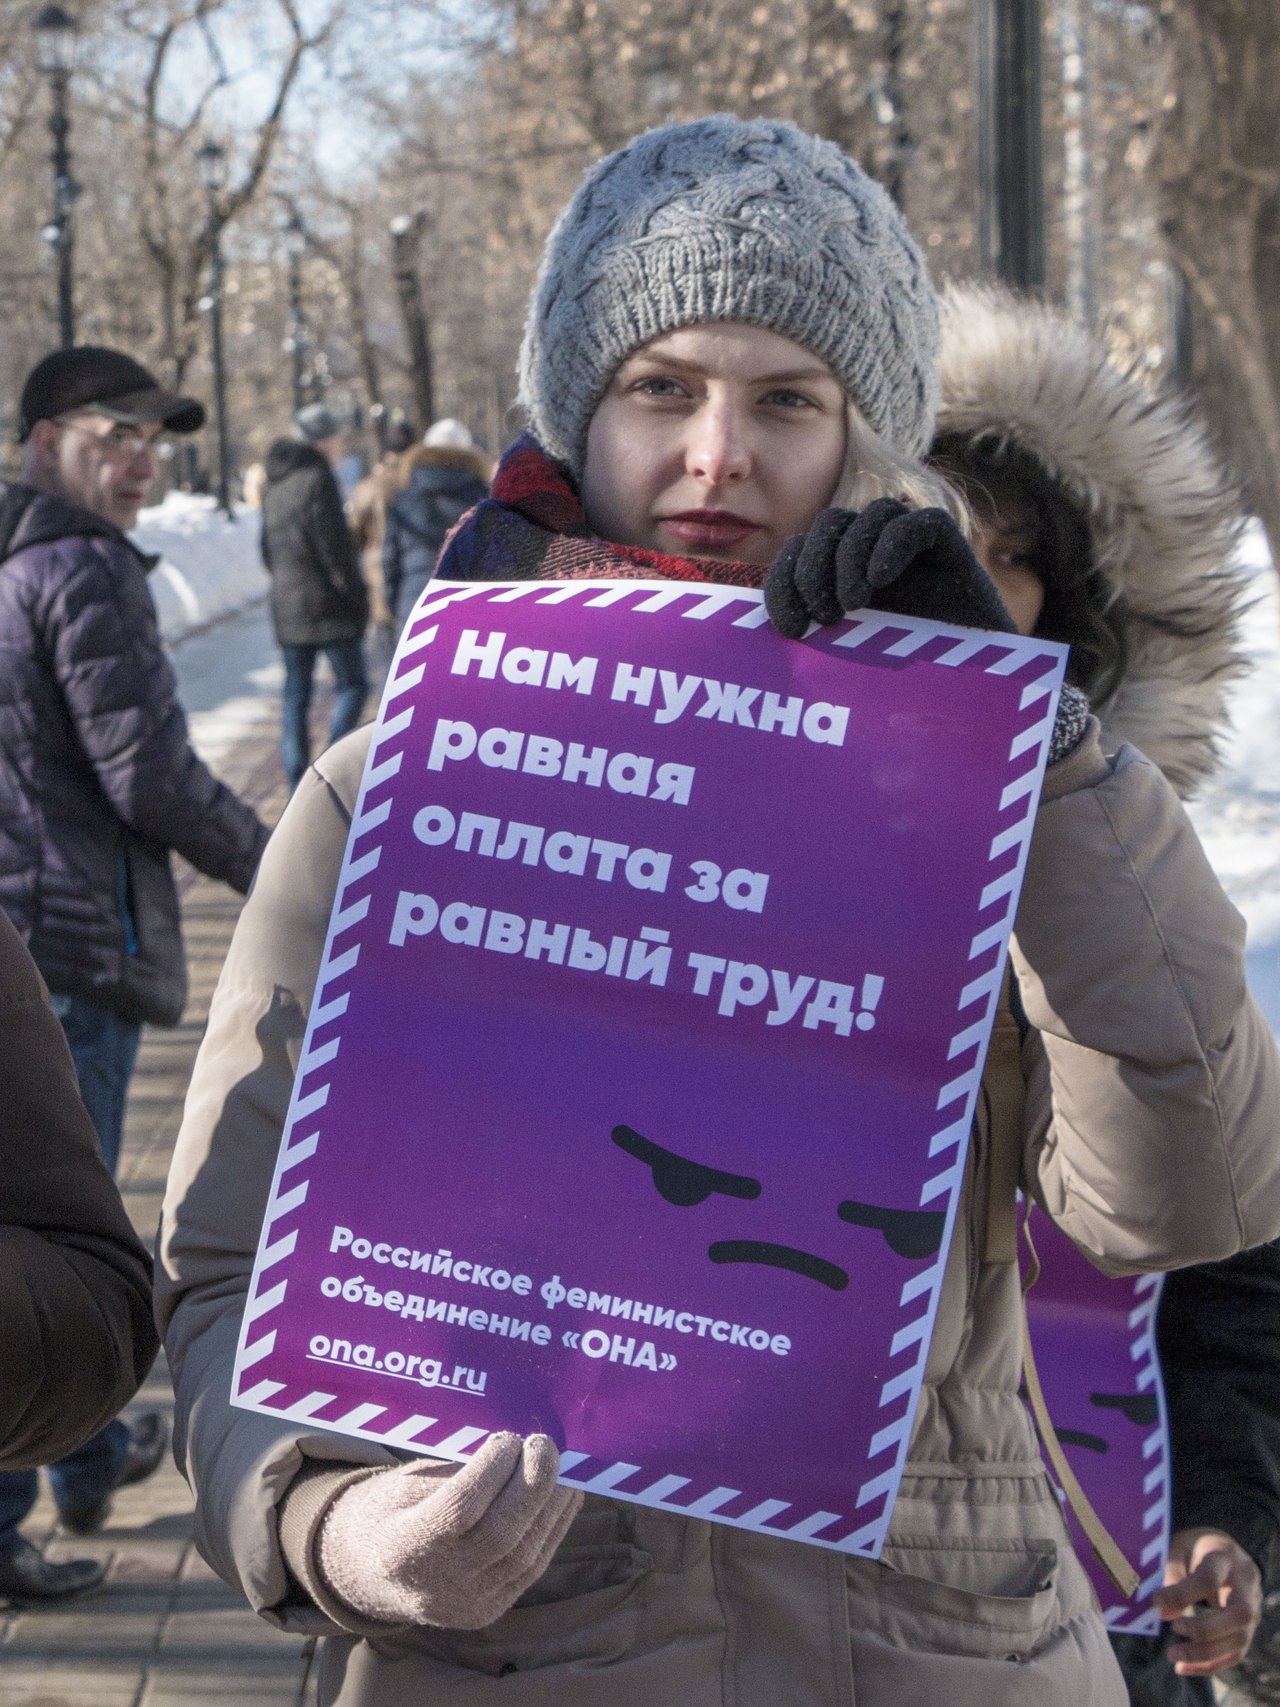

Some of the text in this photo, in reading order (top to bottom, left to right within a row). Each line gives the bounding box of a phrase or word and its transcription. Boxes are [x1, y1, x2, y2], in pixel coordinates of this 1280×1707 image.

[450, 629, 850, 746] Нам нужна
[427, 719, 696, 805] равная
[412, 805, 770, 914] оплата за
[388, 890, 885, 1036] равный труд!
[320, 1274, 678, 1373] объединение «ОНА»
[329, 1226, 792, 1357] Российское феминистское
[309, 1333, 487, 1392] ona.org.ru
